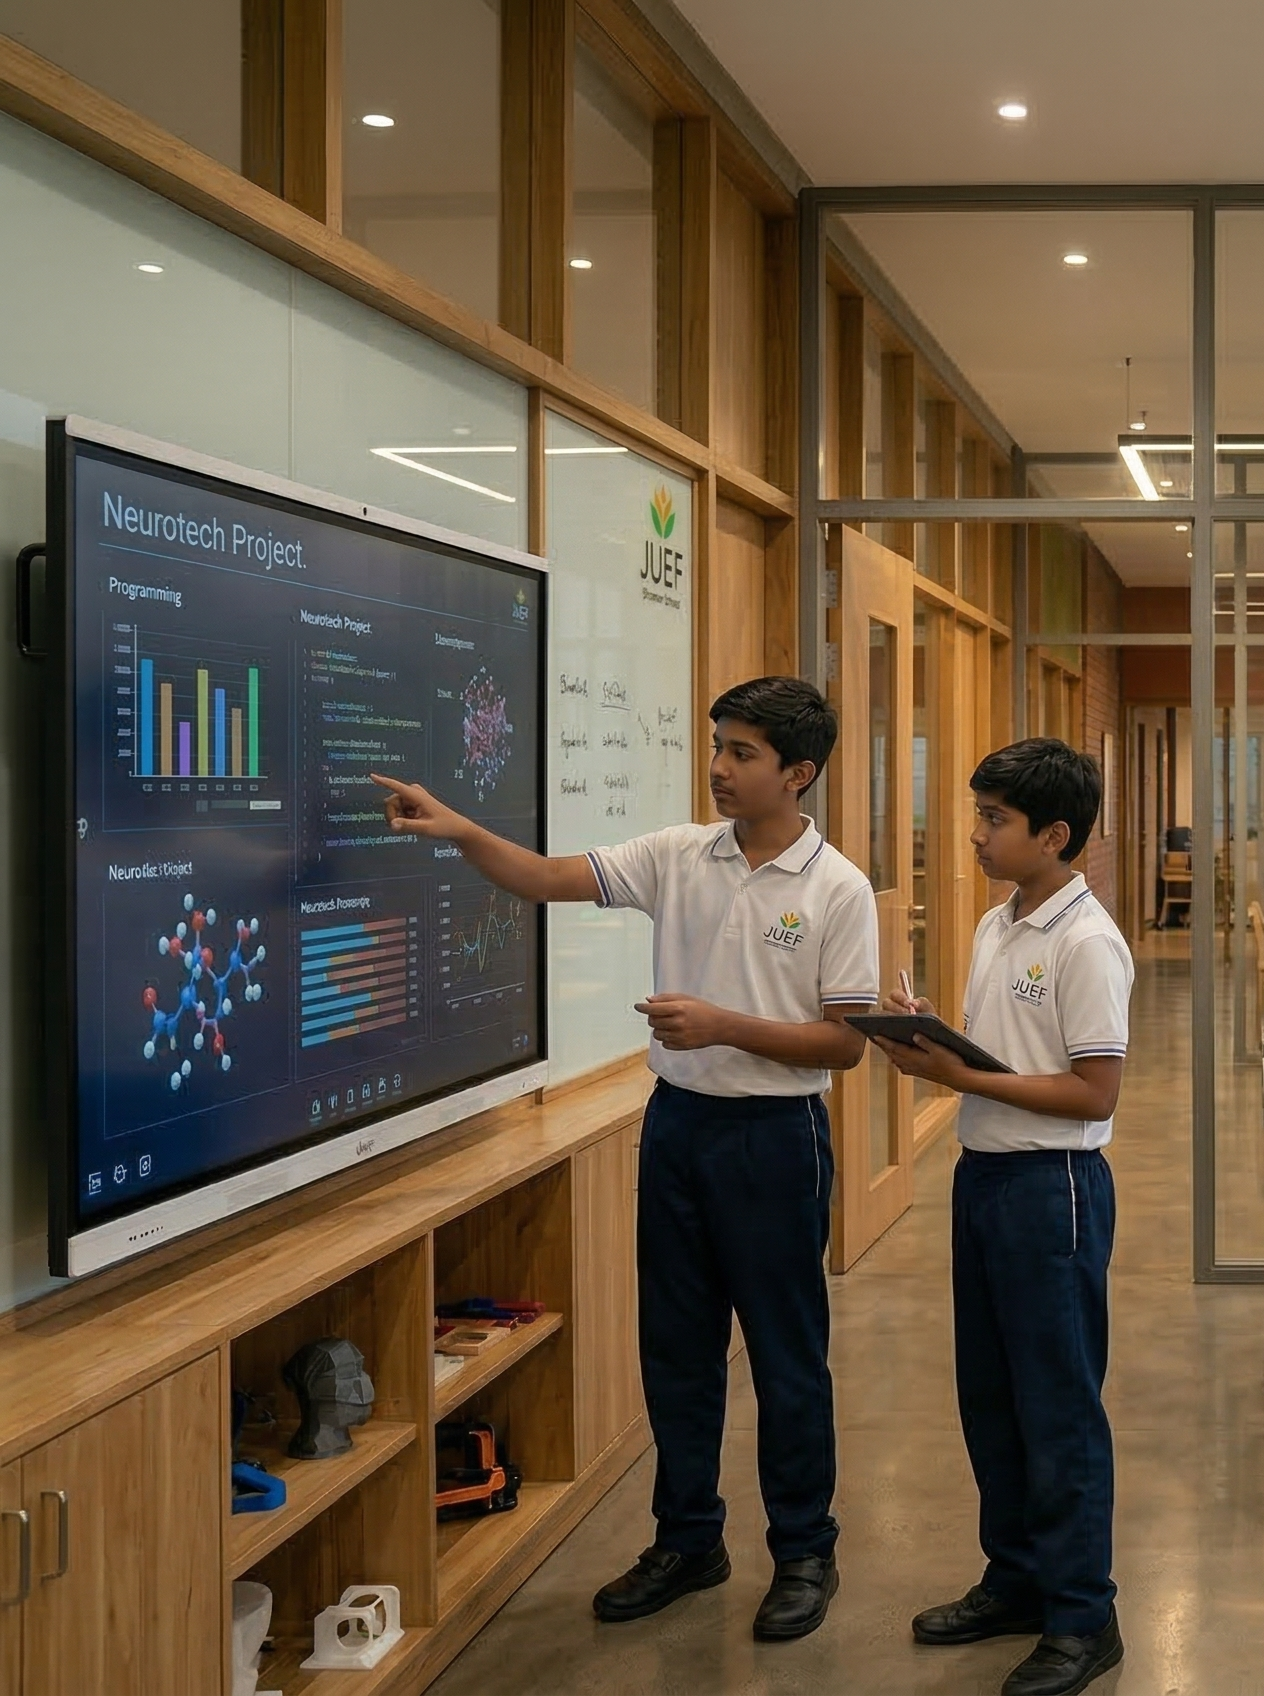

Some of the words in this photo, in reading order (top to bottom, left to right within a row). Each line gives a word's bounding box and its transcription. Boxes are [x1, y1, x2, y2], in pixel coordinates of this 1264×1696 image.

[104, 491, 225, 552] Neurotech
[233, 523, 306, 570] Project.
[640, 540, 683, 591] JUEF
[109, 576, 182, 607] Programming
[763, 926, 804, 946] JUEF
[1012, 979, 1048, 999] JUEF
